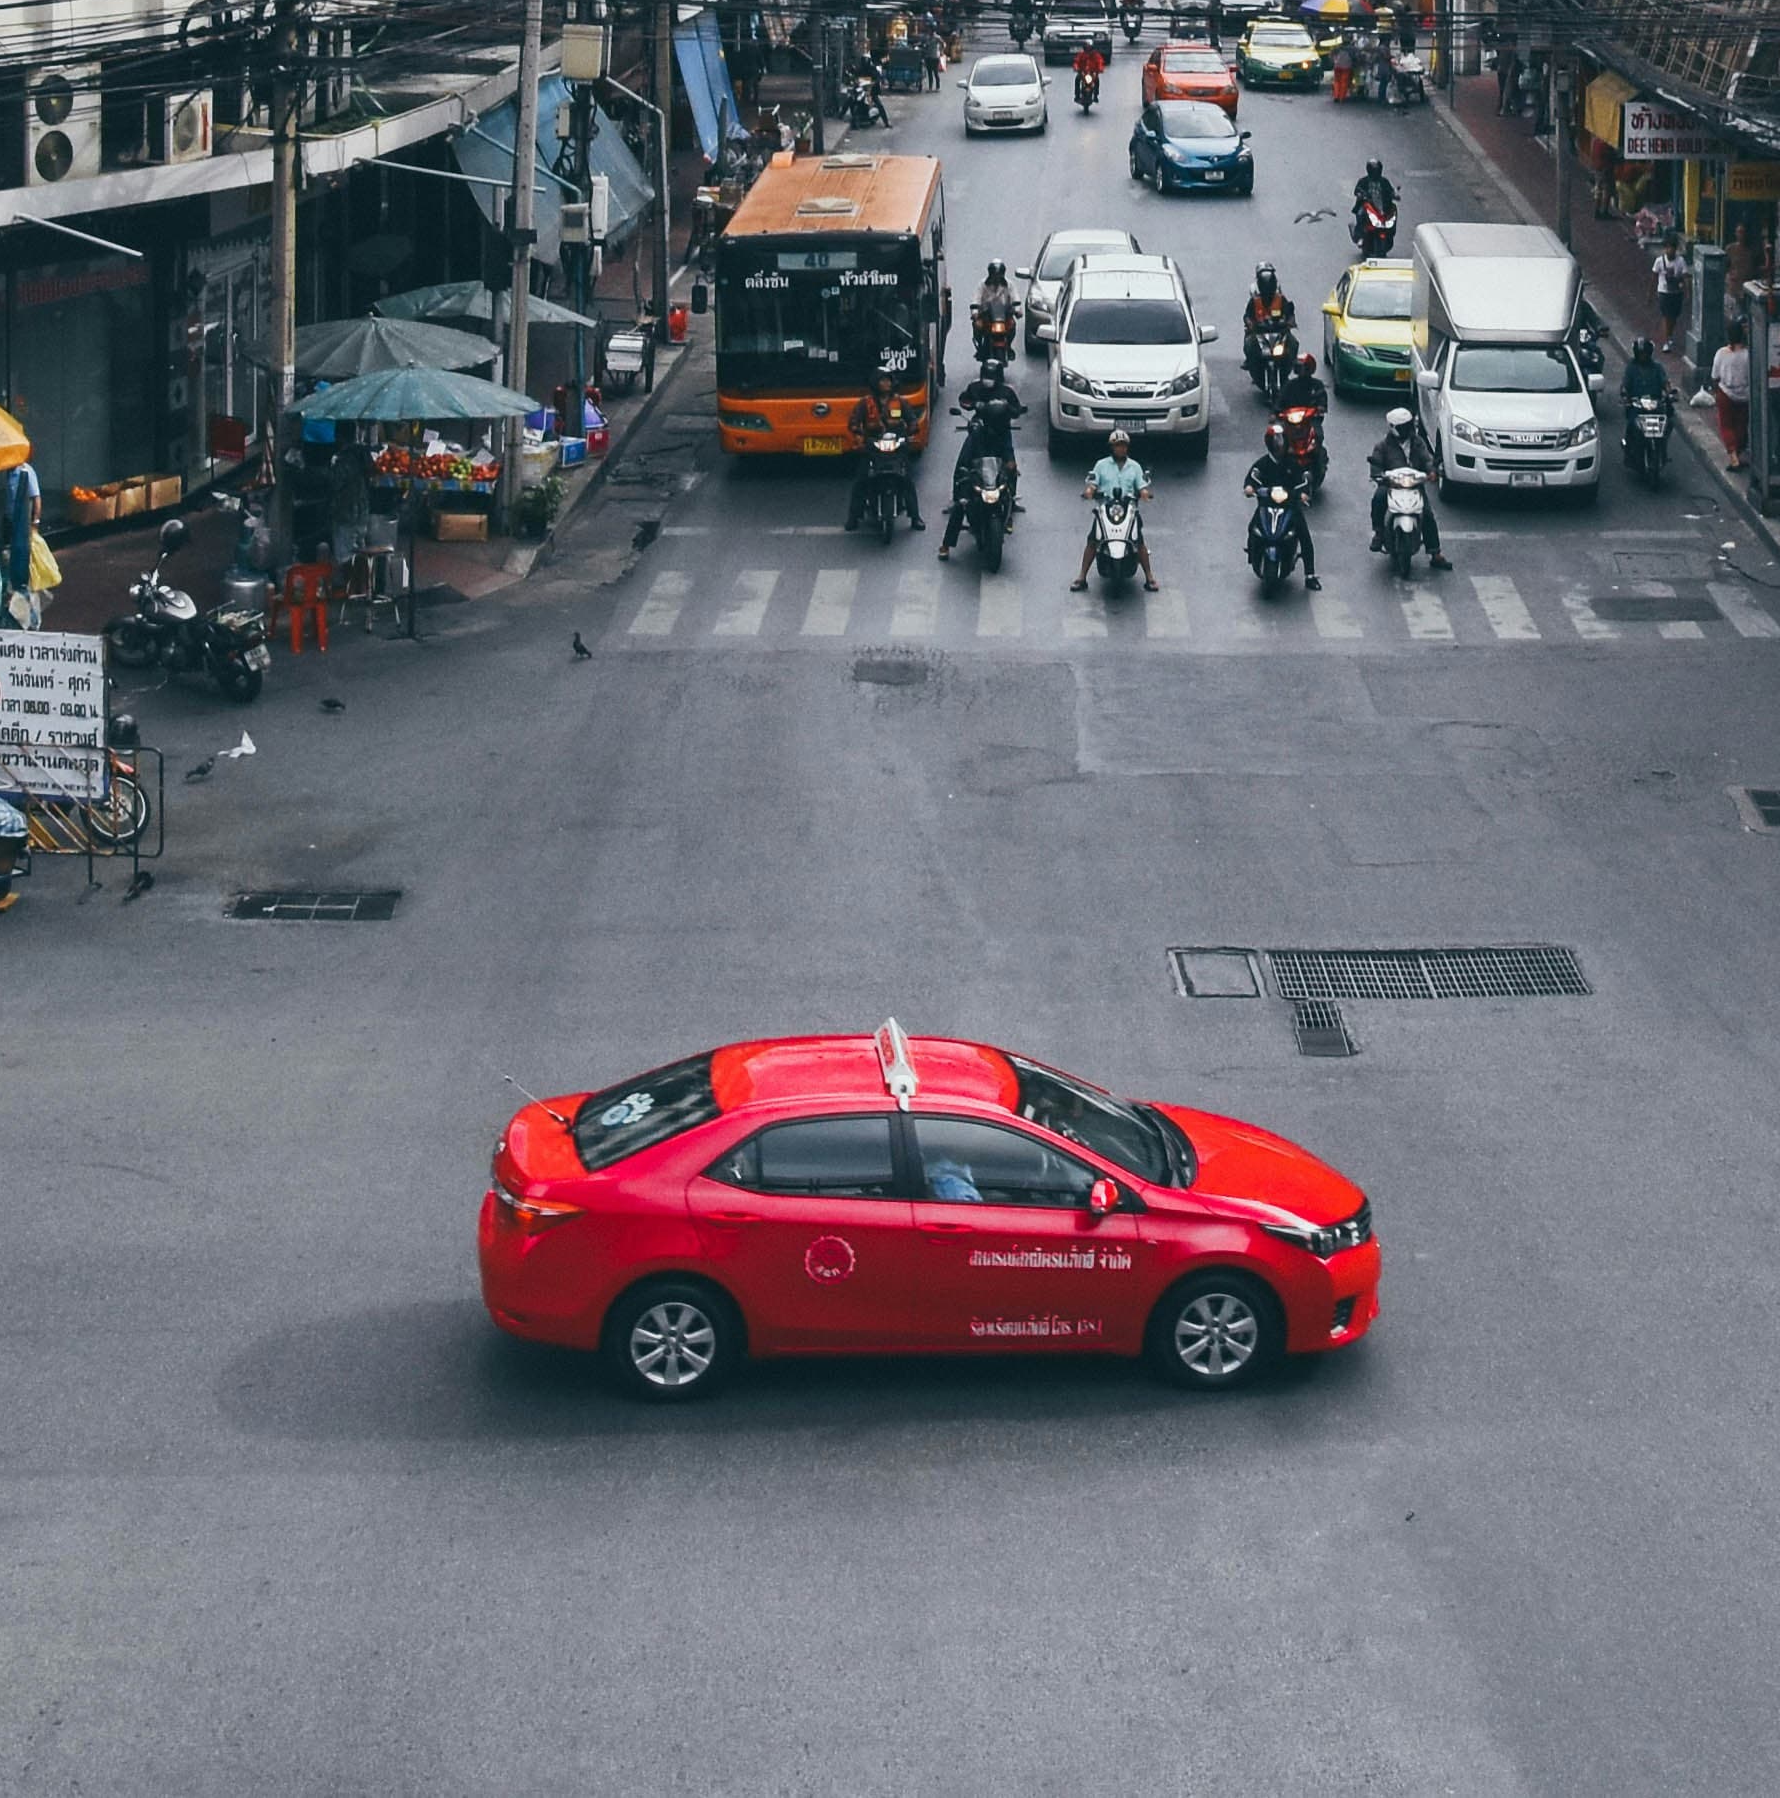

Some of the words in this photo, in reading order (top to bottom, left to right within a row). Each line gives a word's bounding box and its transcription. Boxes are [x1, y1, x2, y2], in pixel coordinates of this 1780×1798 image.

[803, 254, 830, 268] 40
[745, 269, 789, 289] ตลิ่งชัน
[839, 268, 898, 288] หัวลำโพง
[885, 357, 907, 371] 40
[29, 643, 98, 665] เวลาเร่งด่วน
[8, 665, 54, 689] วันจันทร์
[68, 671, 91, 697] ศุกร์
[1099, 1245, 1132, 1270] จำกัด
